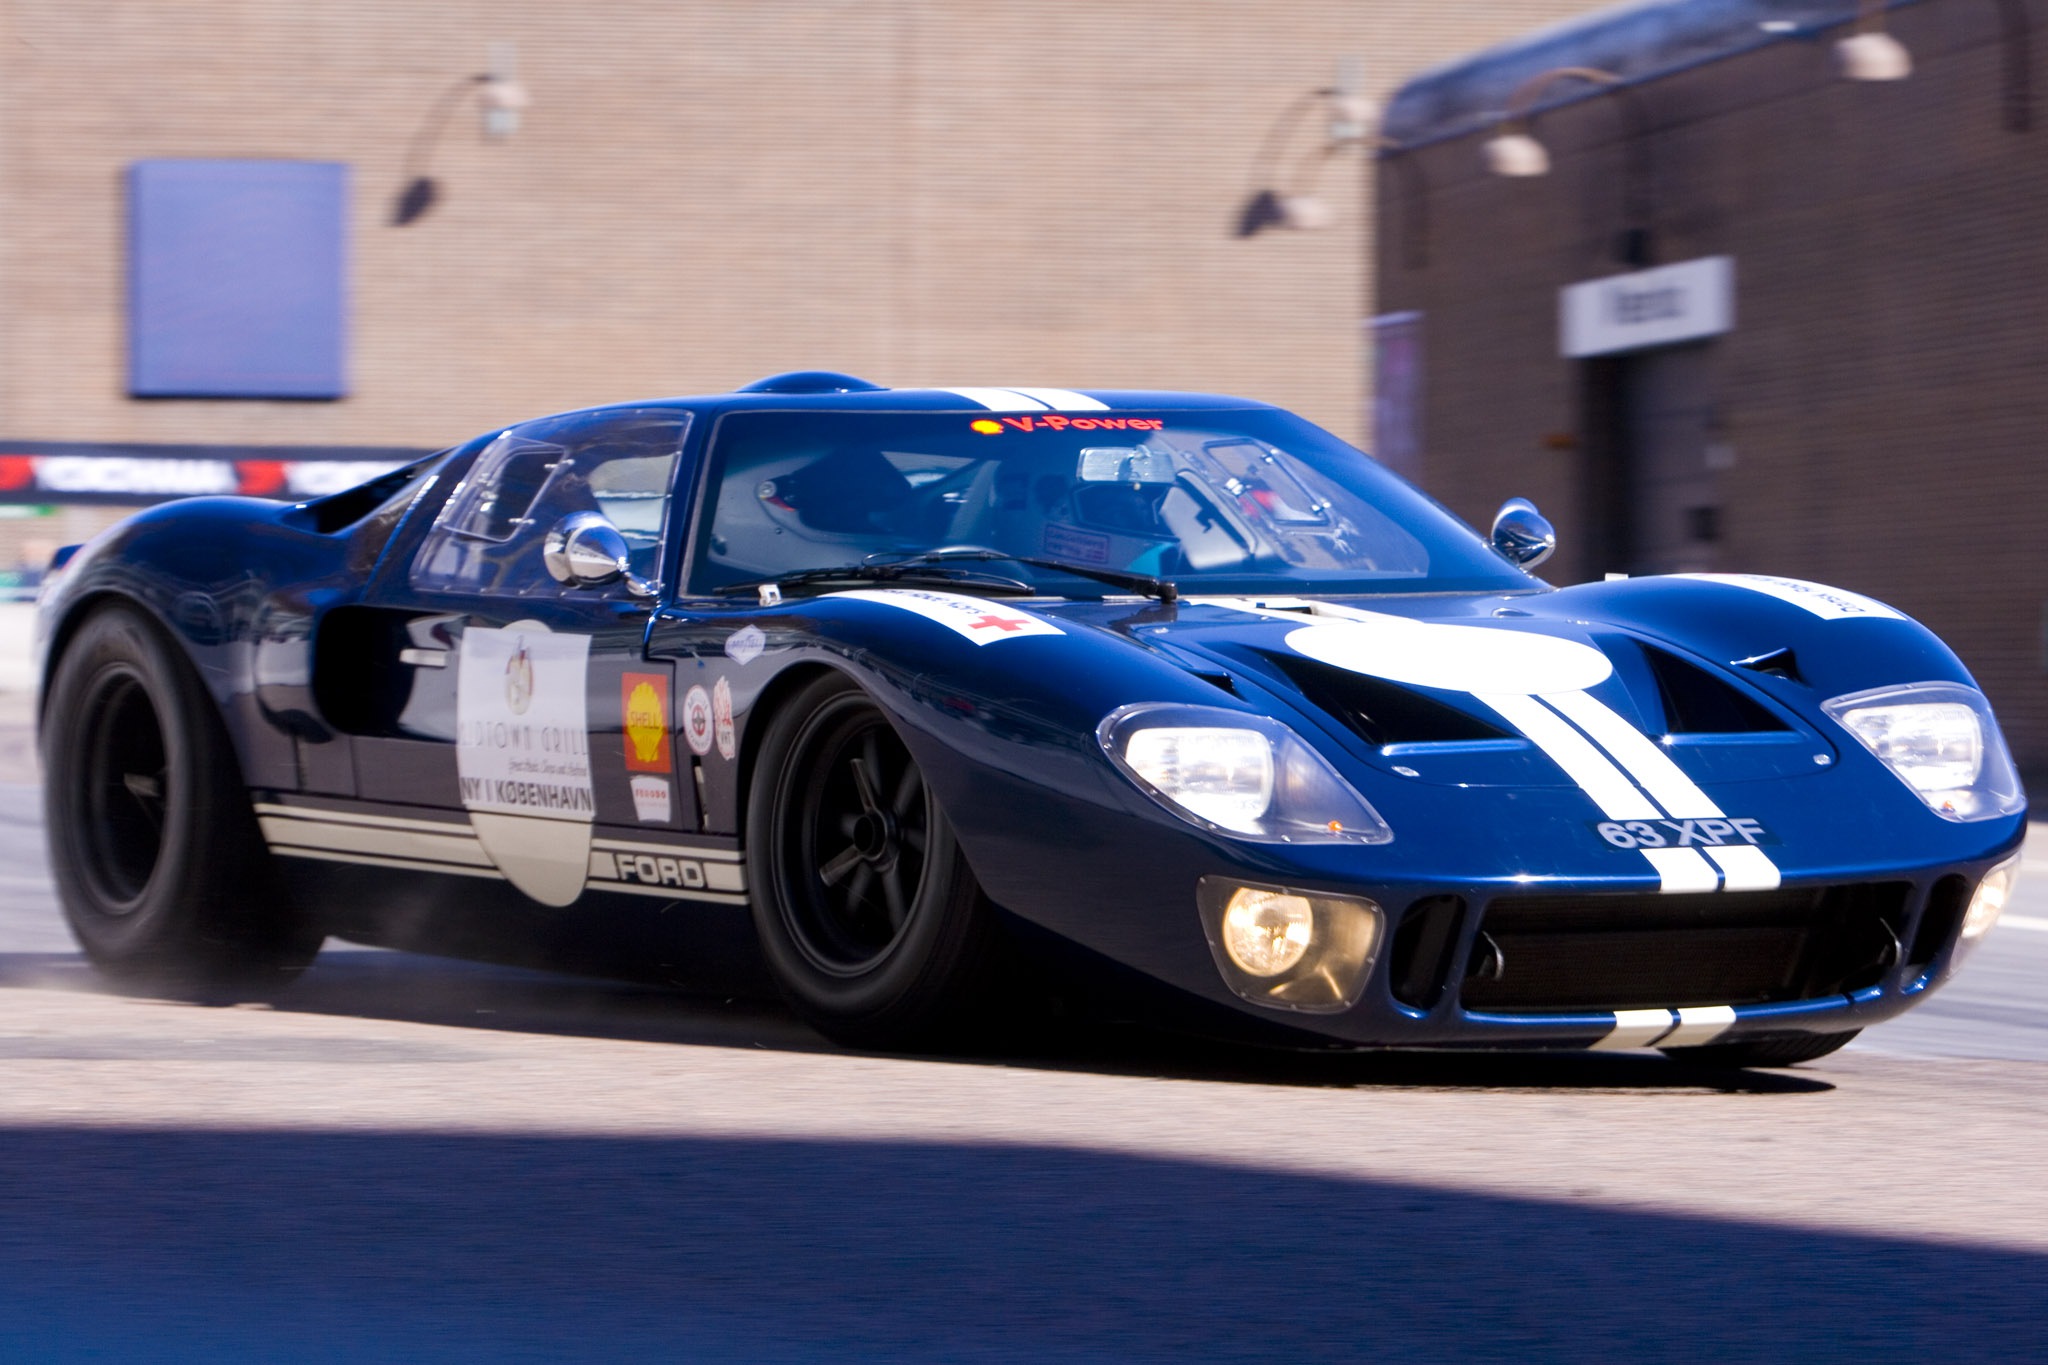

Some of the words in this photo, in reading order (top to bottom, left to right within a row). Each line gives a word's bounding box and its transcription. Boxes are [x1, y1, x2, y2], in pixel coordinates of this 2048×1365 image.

[1001, 414, 1163, 433] V-Power
[630, 711, 660, 730] SHELL
[541, 726, 589, 755] GRILL
[460, 777, 481, 800] NY
[486, 779, 492, 802] I
[495, 780, 593, 811] KØBENHAVN
[1597, 821, 1667, 849] 63
[1658, 818, 1766, 847] XPF
[616, 853, 705, 888] FORD
